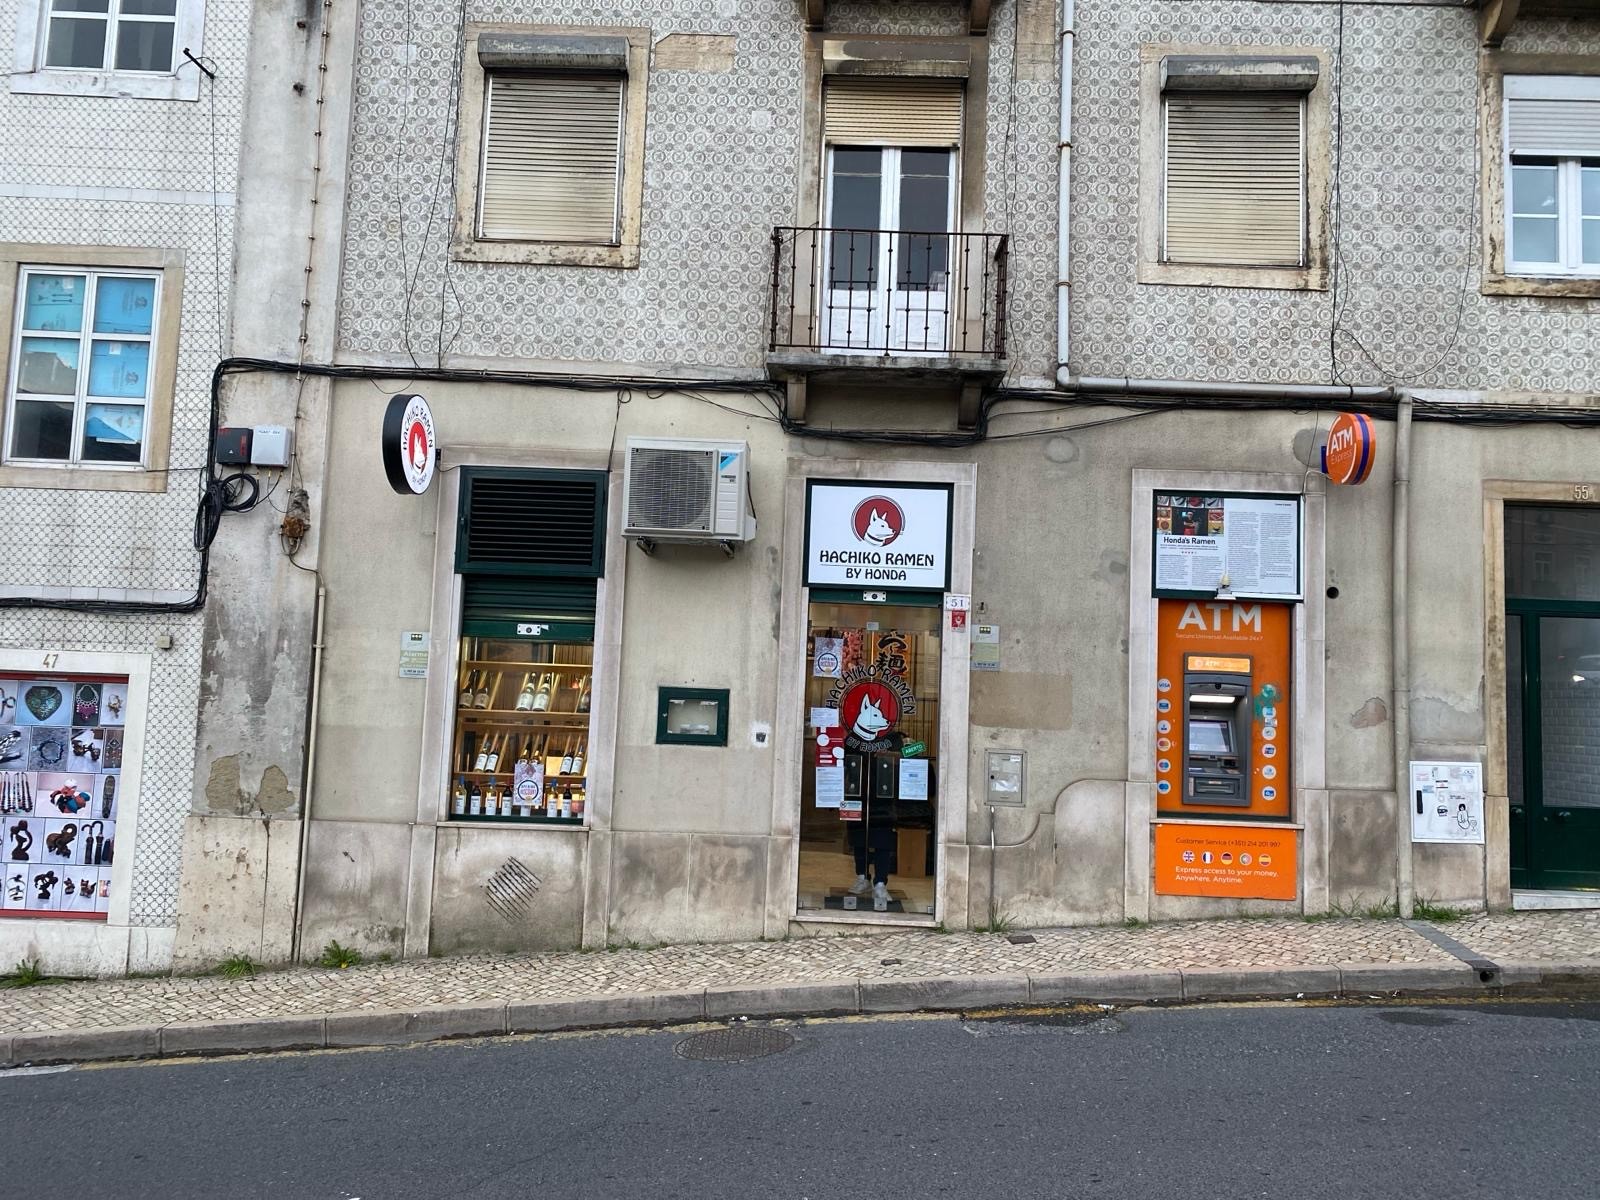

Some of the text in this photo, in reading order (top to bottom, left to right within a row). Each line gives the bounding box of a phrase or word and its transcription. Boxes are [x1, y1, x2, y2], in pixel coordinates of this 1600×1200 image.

[1331, 426, 1353, 454] ATM
[1574, 485, 1589, 500] 55
[1163, 536, 1216, 545] Honda's Ramen
[820, 550, 934, 566] HACHIKO RAMEN
[846, 567, 907, 581] BY HONDA
[951, 598, 964, 608] 51
[1177, 602, 1262, 633] ATM
[42, 653, 59, 669] 47
[825, 664, 915, 715] HACHIKO RAMEN
[904, 744, 924, 754] ABERTO
[1175, 838, 1205, 846] Customer
[1175, 866, 1202, 874] Express
